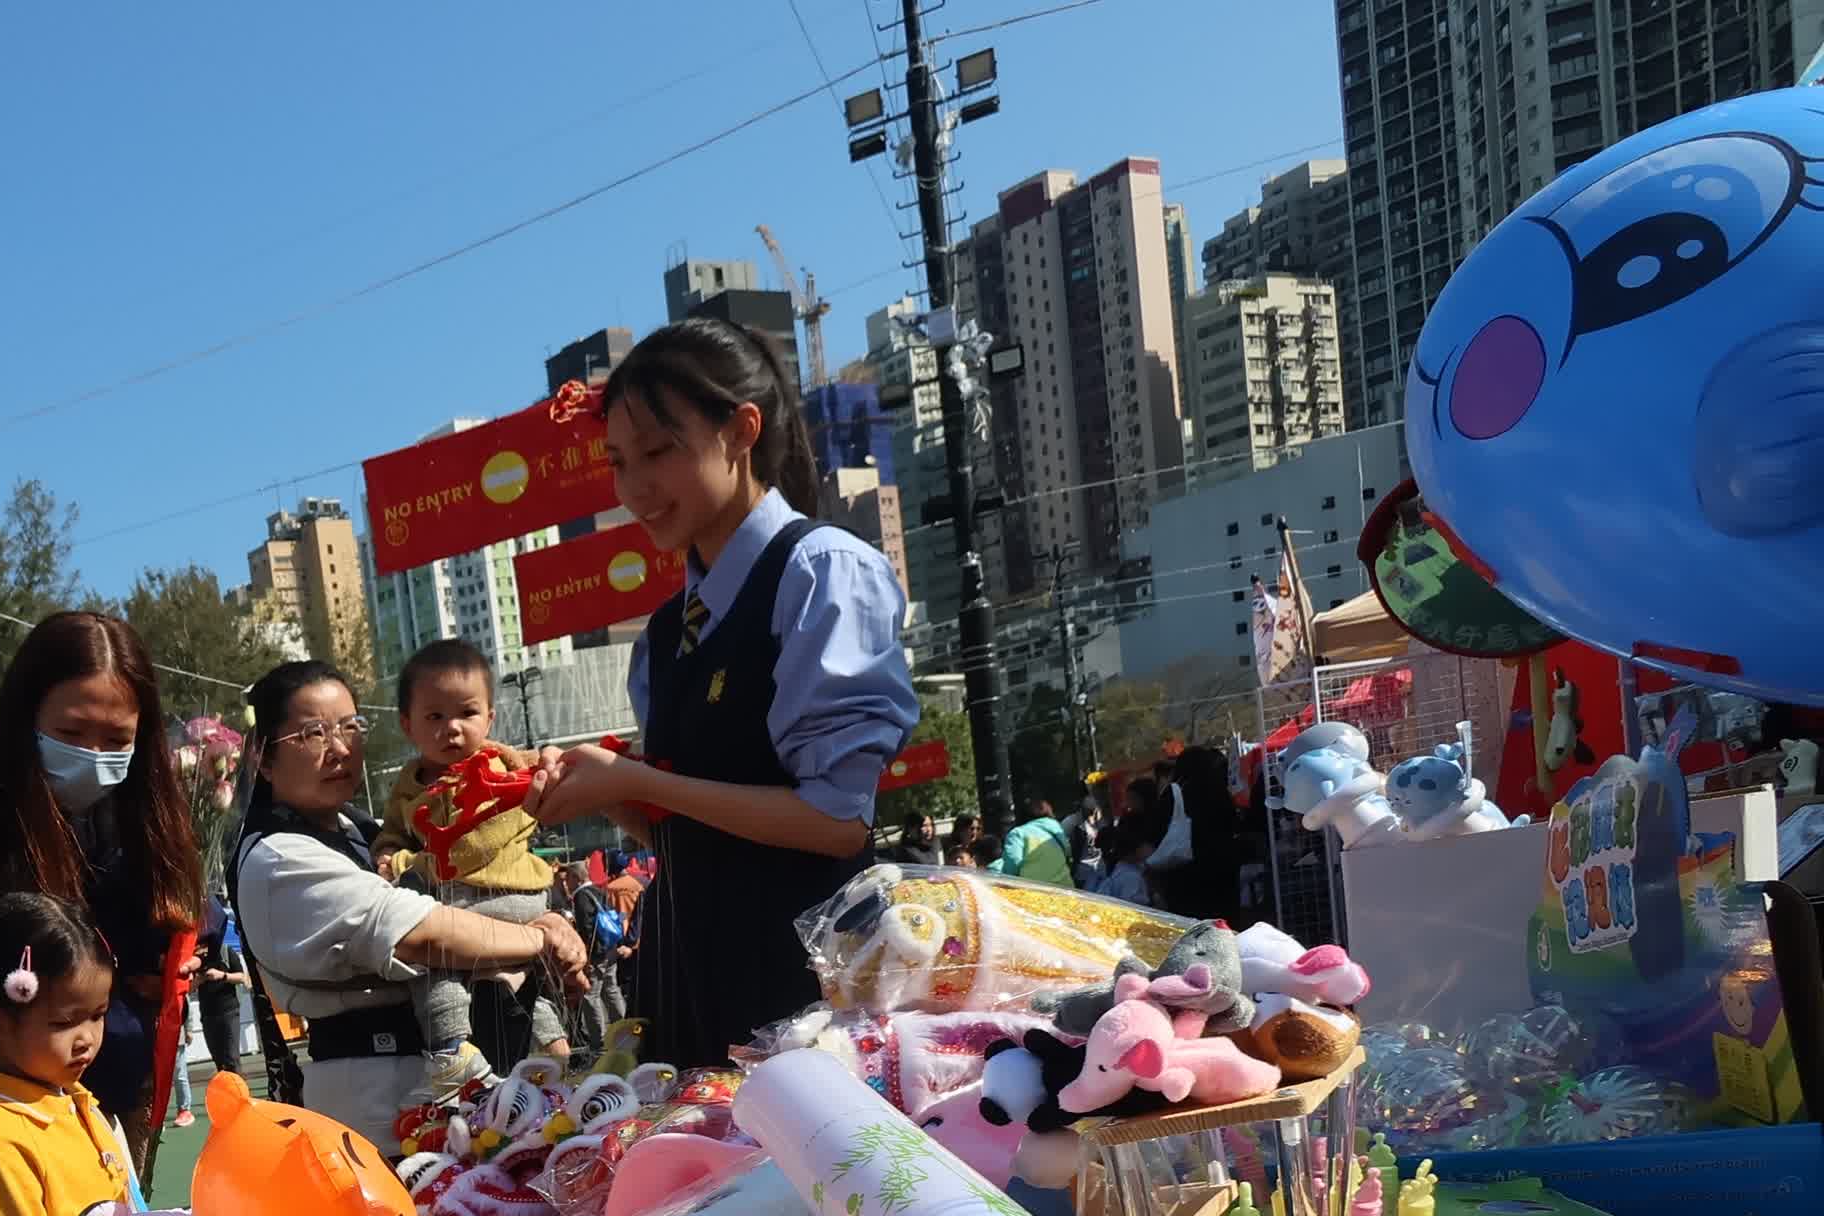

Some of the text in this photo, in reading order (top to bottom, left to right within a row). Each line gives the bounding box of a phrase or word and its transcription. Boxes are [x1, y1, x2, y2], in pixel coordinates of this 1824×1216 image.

[384, 482, 474, 521] NO ENTRY
[529, 574, 601, 604] NO ENTRY
